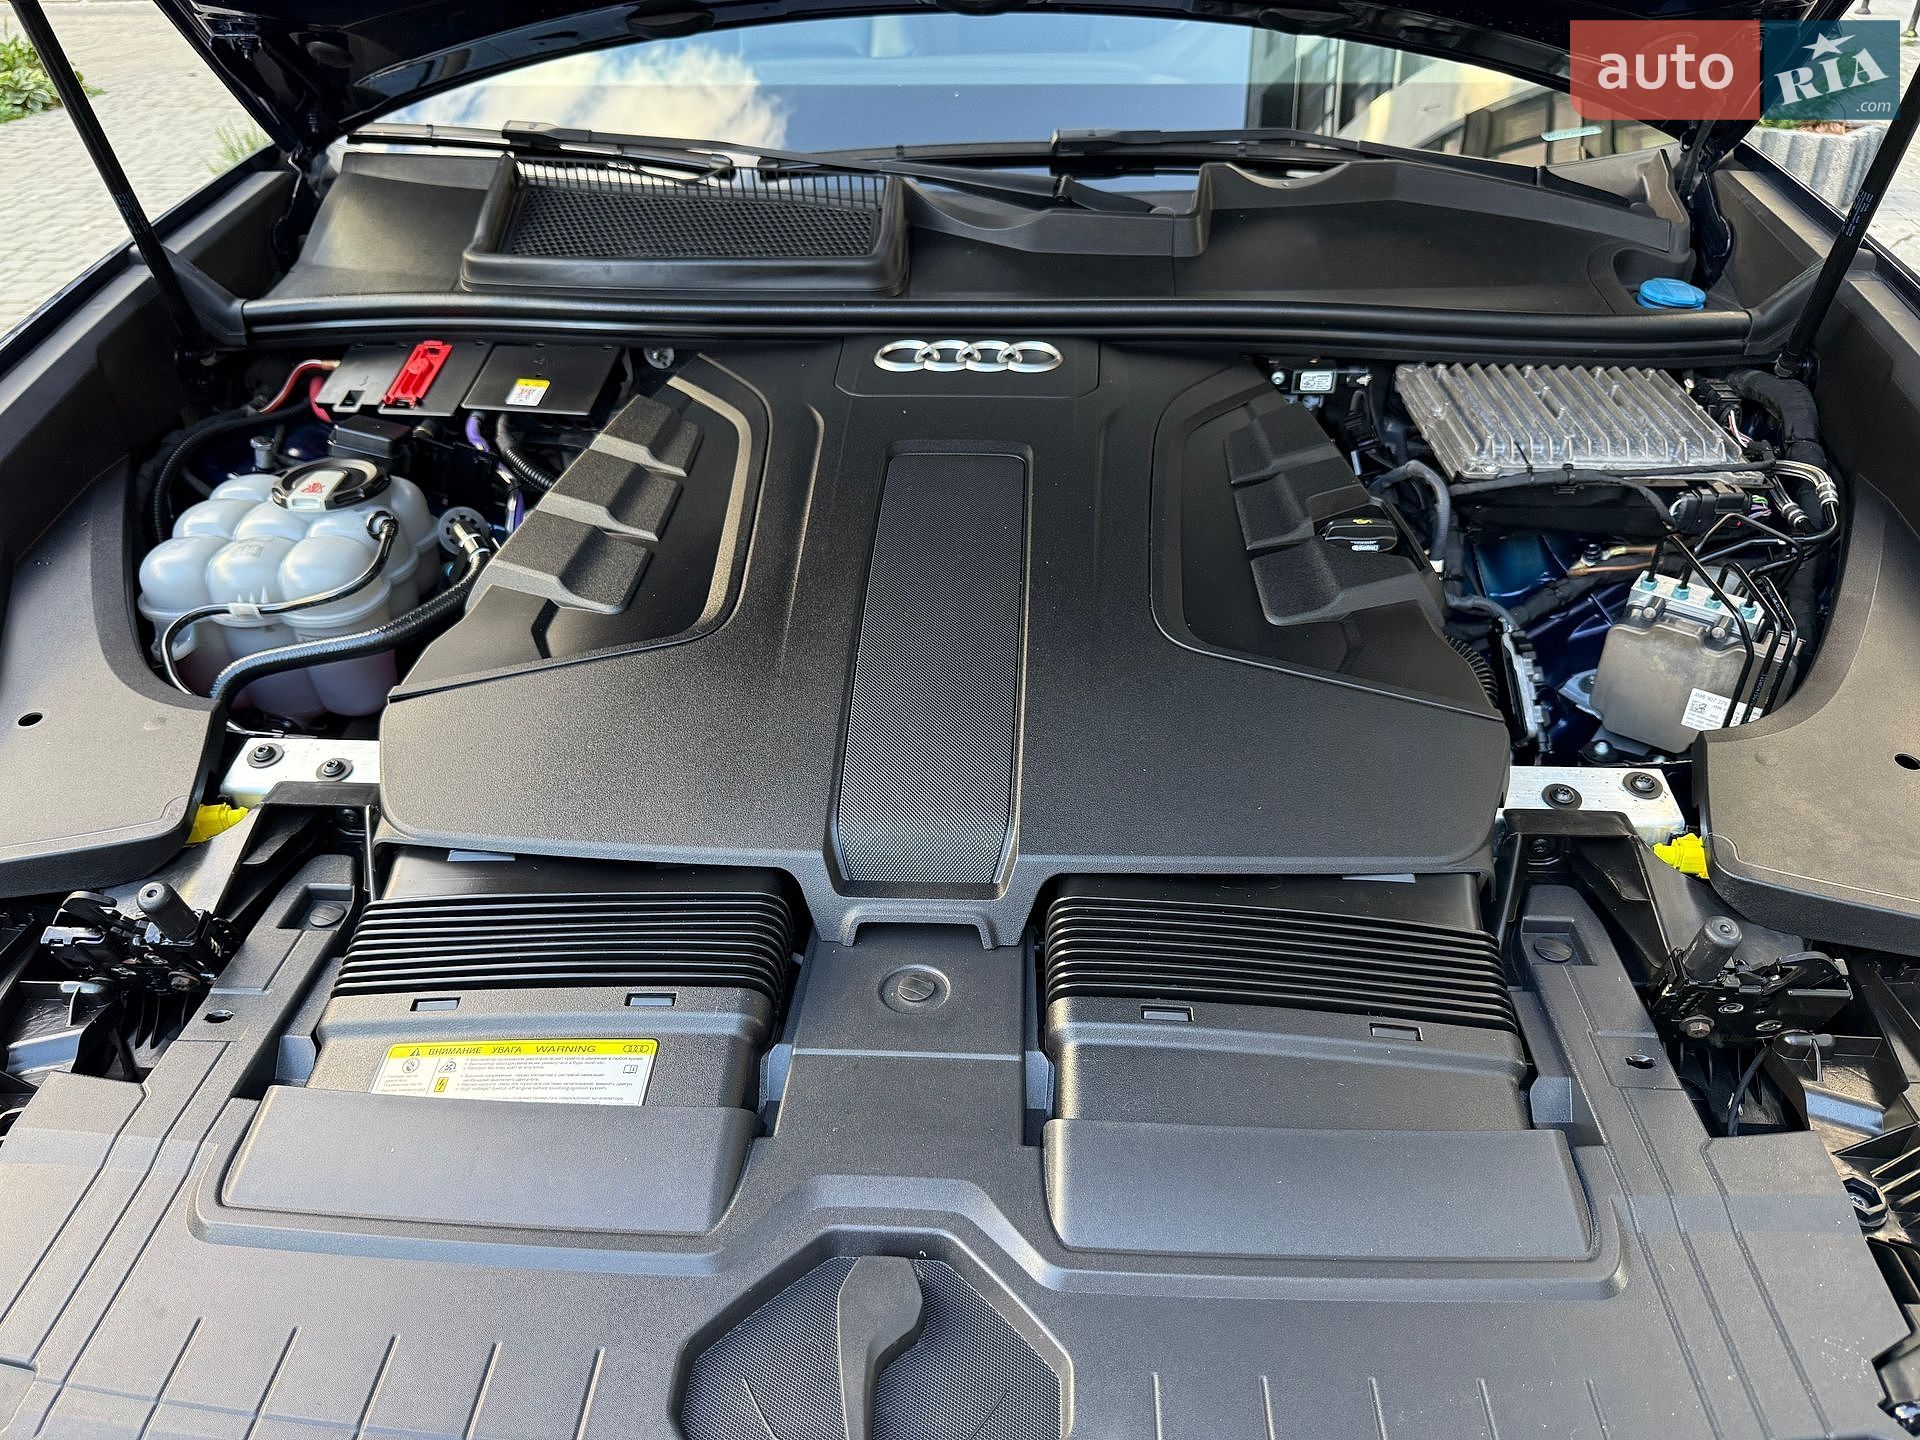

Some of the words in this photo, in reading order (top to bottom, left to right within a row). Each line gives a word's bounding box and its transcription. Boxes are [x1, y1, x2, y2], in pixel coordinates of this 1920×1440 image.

[428, 1046, 482, 1056] ВНИМАНИЕ
[491, 1046, 522, 1055] УВАГА
[535, 1045, 596, 1054] WARNING
